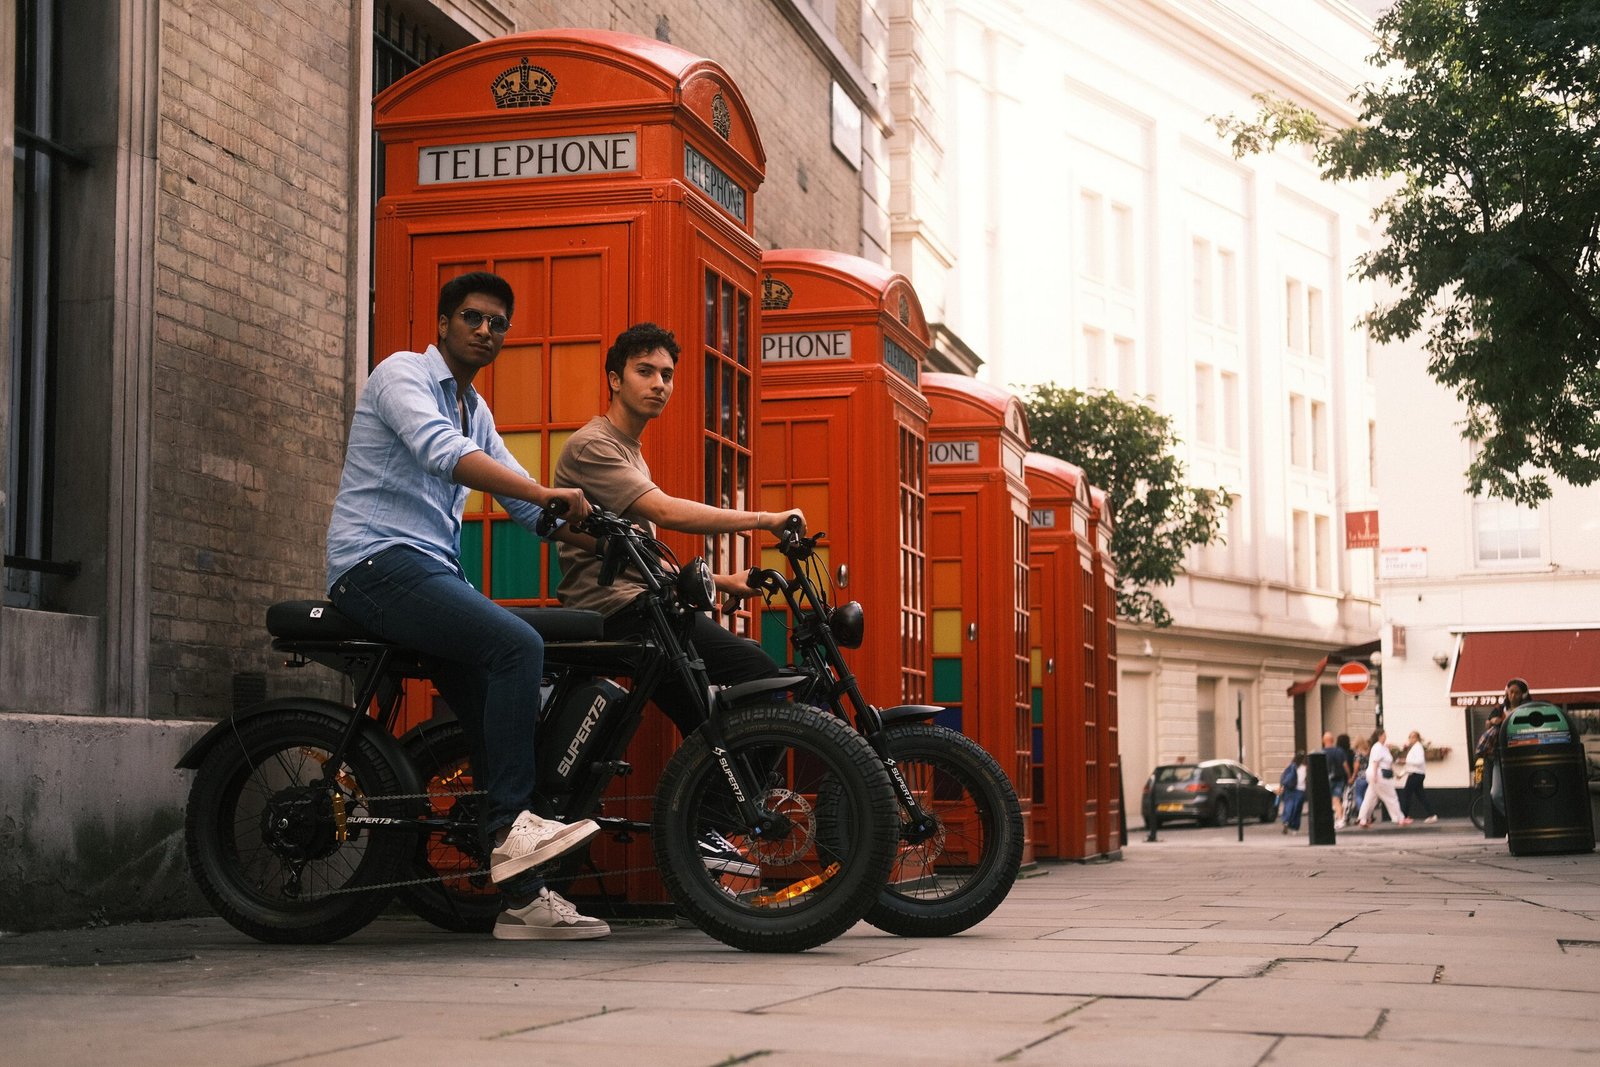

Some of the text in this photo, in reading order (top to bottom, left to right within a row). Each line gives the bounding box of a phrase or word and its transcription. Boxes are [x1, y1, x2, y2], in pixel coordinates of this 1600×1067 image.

[427, 138, 631, 181] TELEPHONE
[686, 148, 743, 220] TELEPHONE
[762, 333, 846, 359] PHONE
[557, 694, 607, 777] SUPER73
[719, 757, 745, 802] SUPER73
[891, 767, 915, 806] SUPER73
[346, 816, 392, 825] SUPER73
